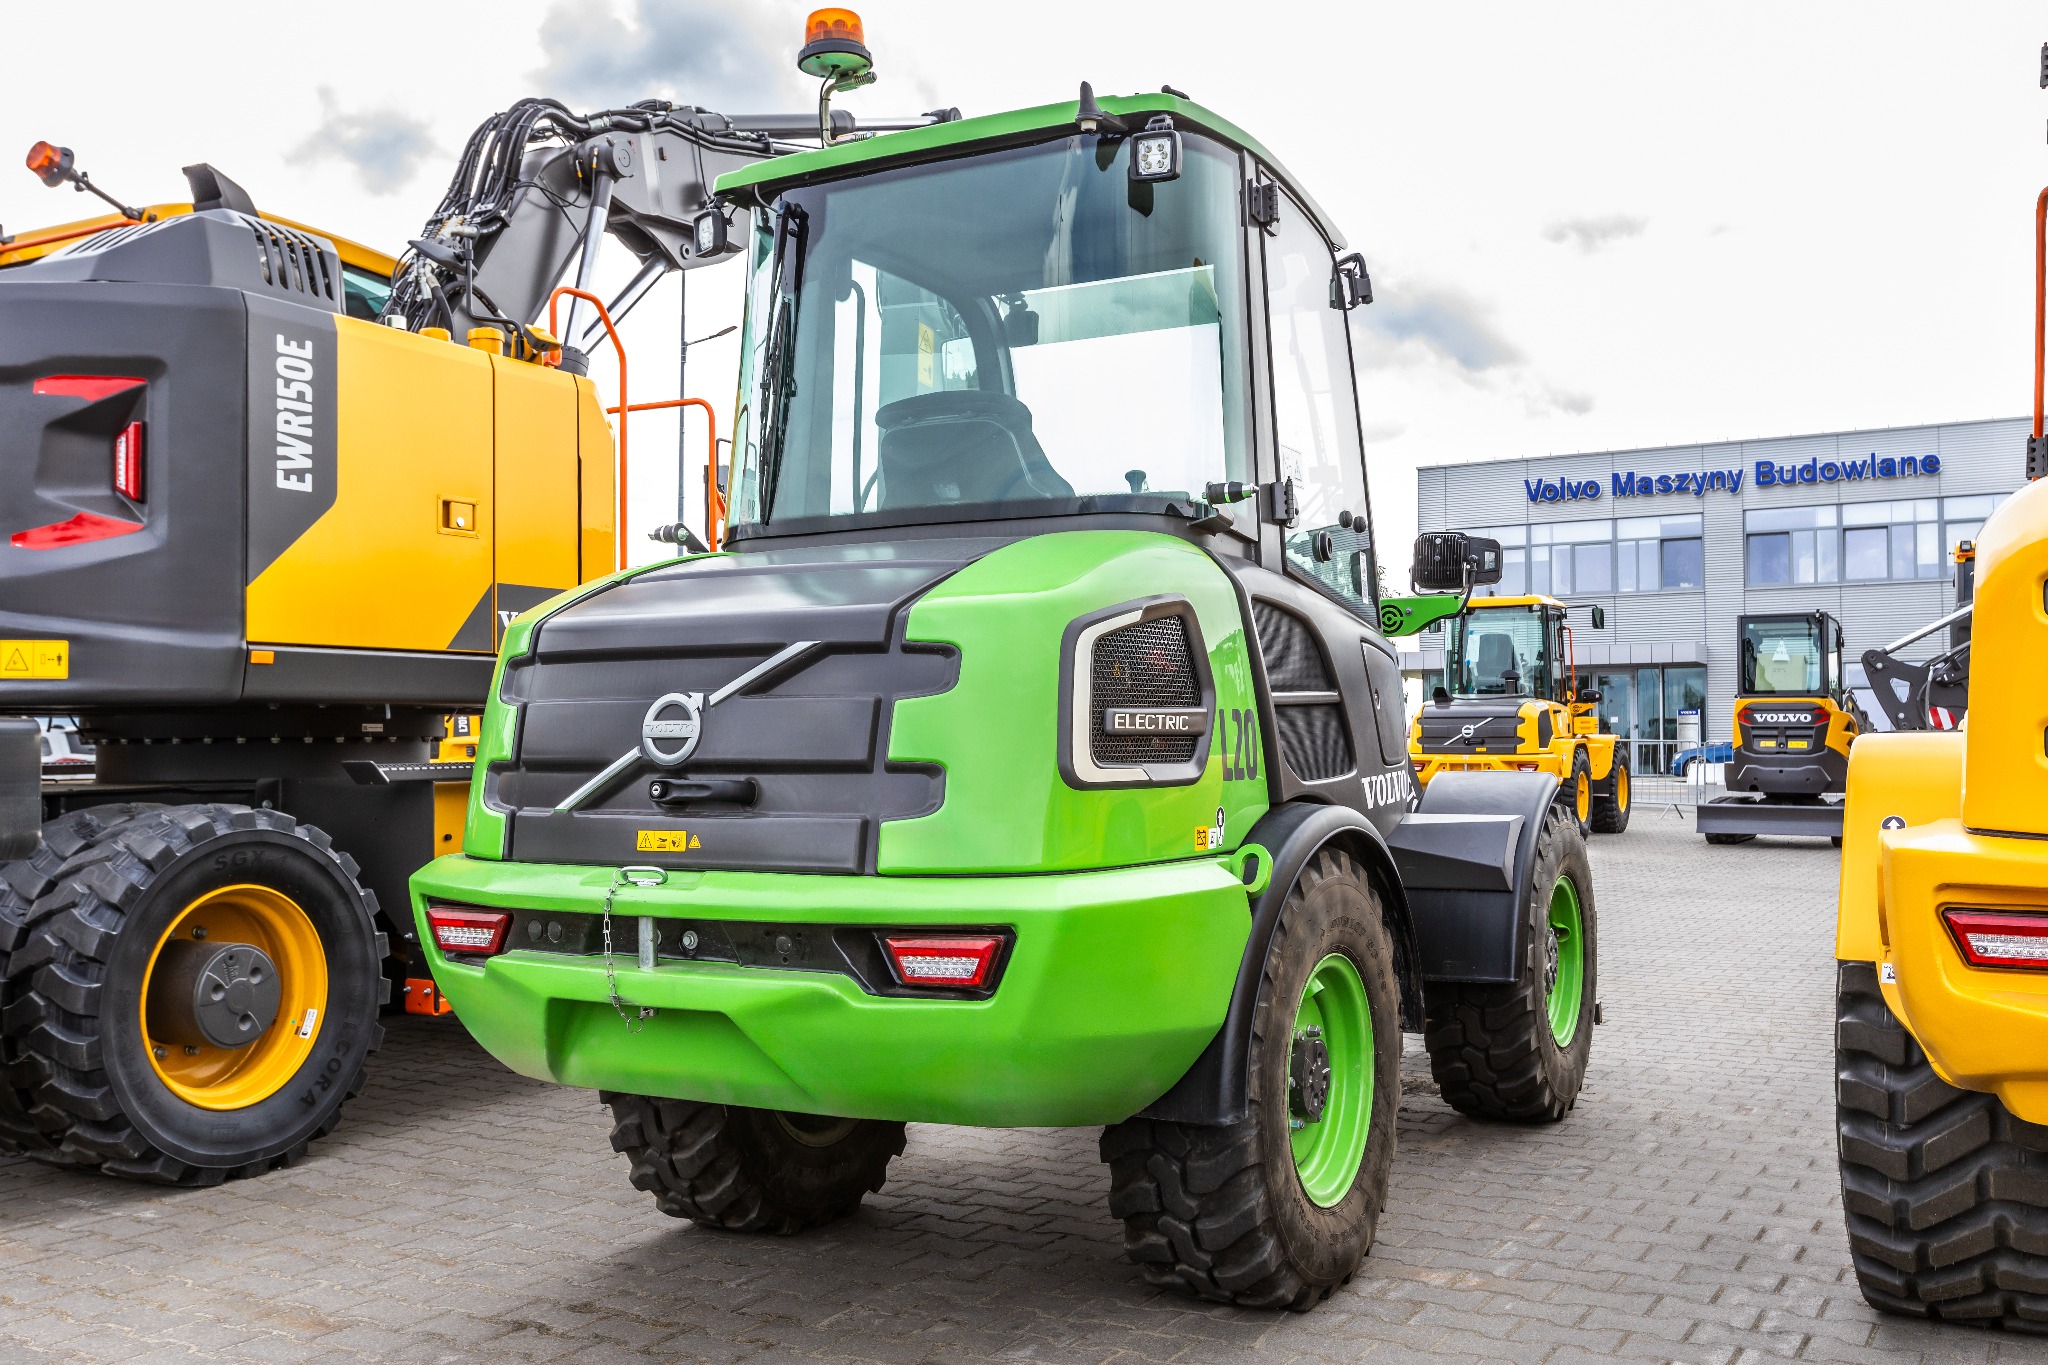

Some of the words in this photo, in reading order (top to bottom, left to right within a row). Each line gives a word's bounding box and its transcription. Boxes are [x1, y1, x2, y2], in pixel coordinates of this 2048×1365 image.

[276, 334, 313, 493] EWR150E
[1524, 476, 1601, 502] Volvo
[1612, 467, 1744, 497] Maszyny
[1755, 452, 1942, 487] Budowlane
[1114, 713, 1189, 731] ELECTRIC
[1753, 713, 1812, 723] VOLVO
[1218, 708, 1258, 782] L20
[1361, 769, 1407, 810] VOLVO
